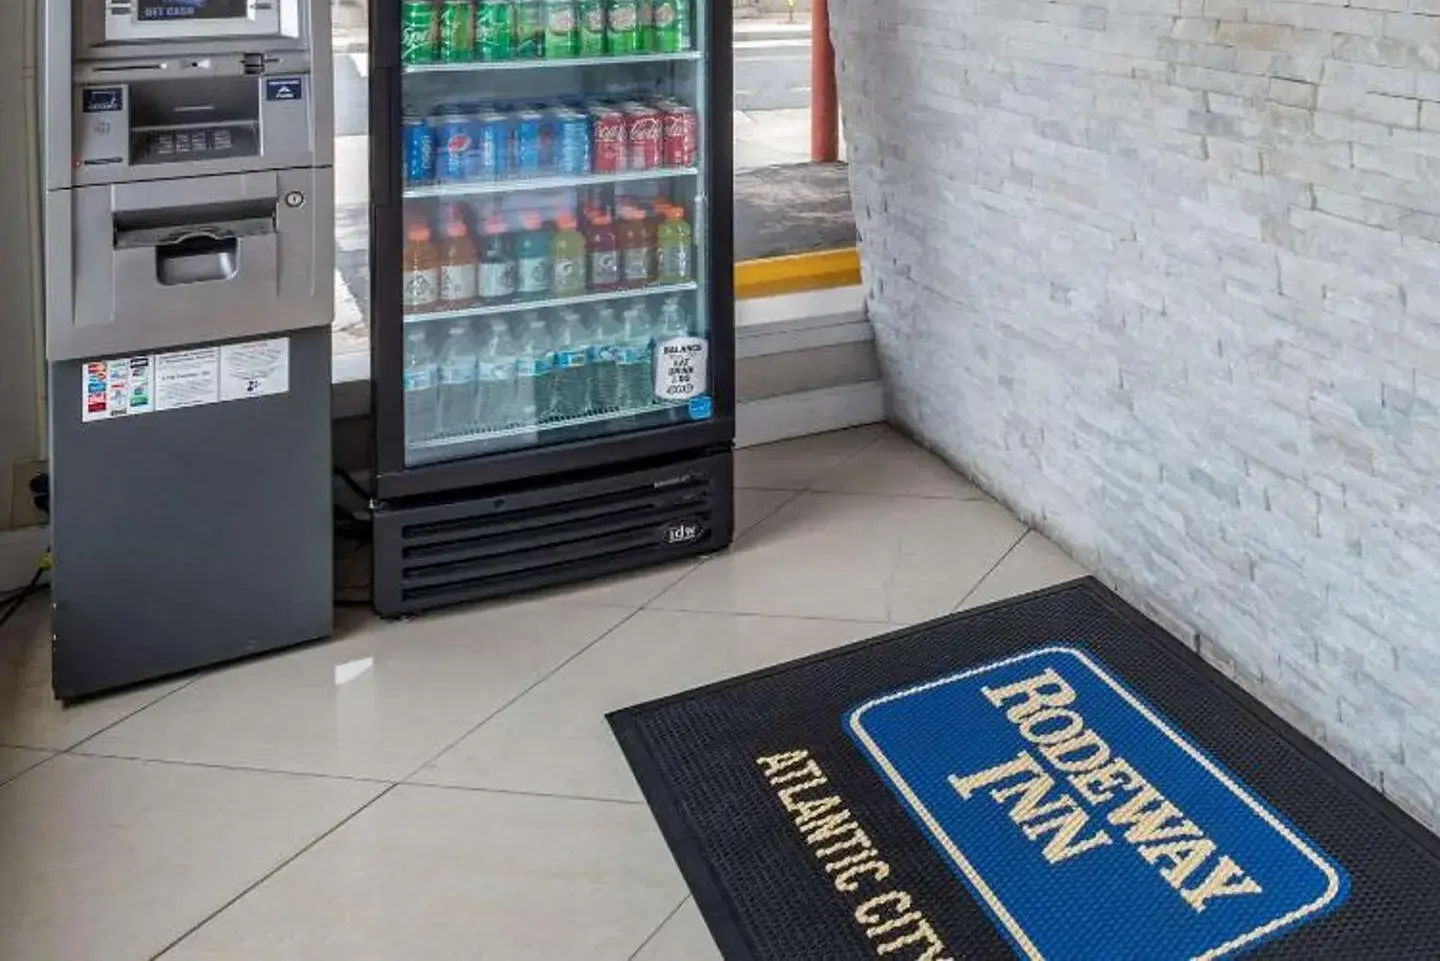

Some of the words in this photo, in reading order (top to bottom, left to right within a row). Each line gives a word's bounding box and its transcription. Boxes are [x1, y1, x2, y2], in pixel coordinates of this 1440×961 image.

[756, 749, 890, 892] ATLANTIC
[947, 750, 1112, 864] INN
[981, 668, 1262, 913] RODEWAY
